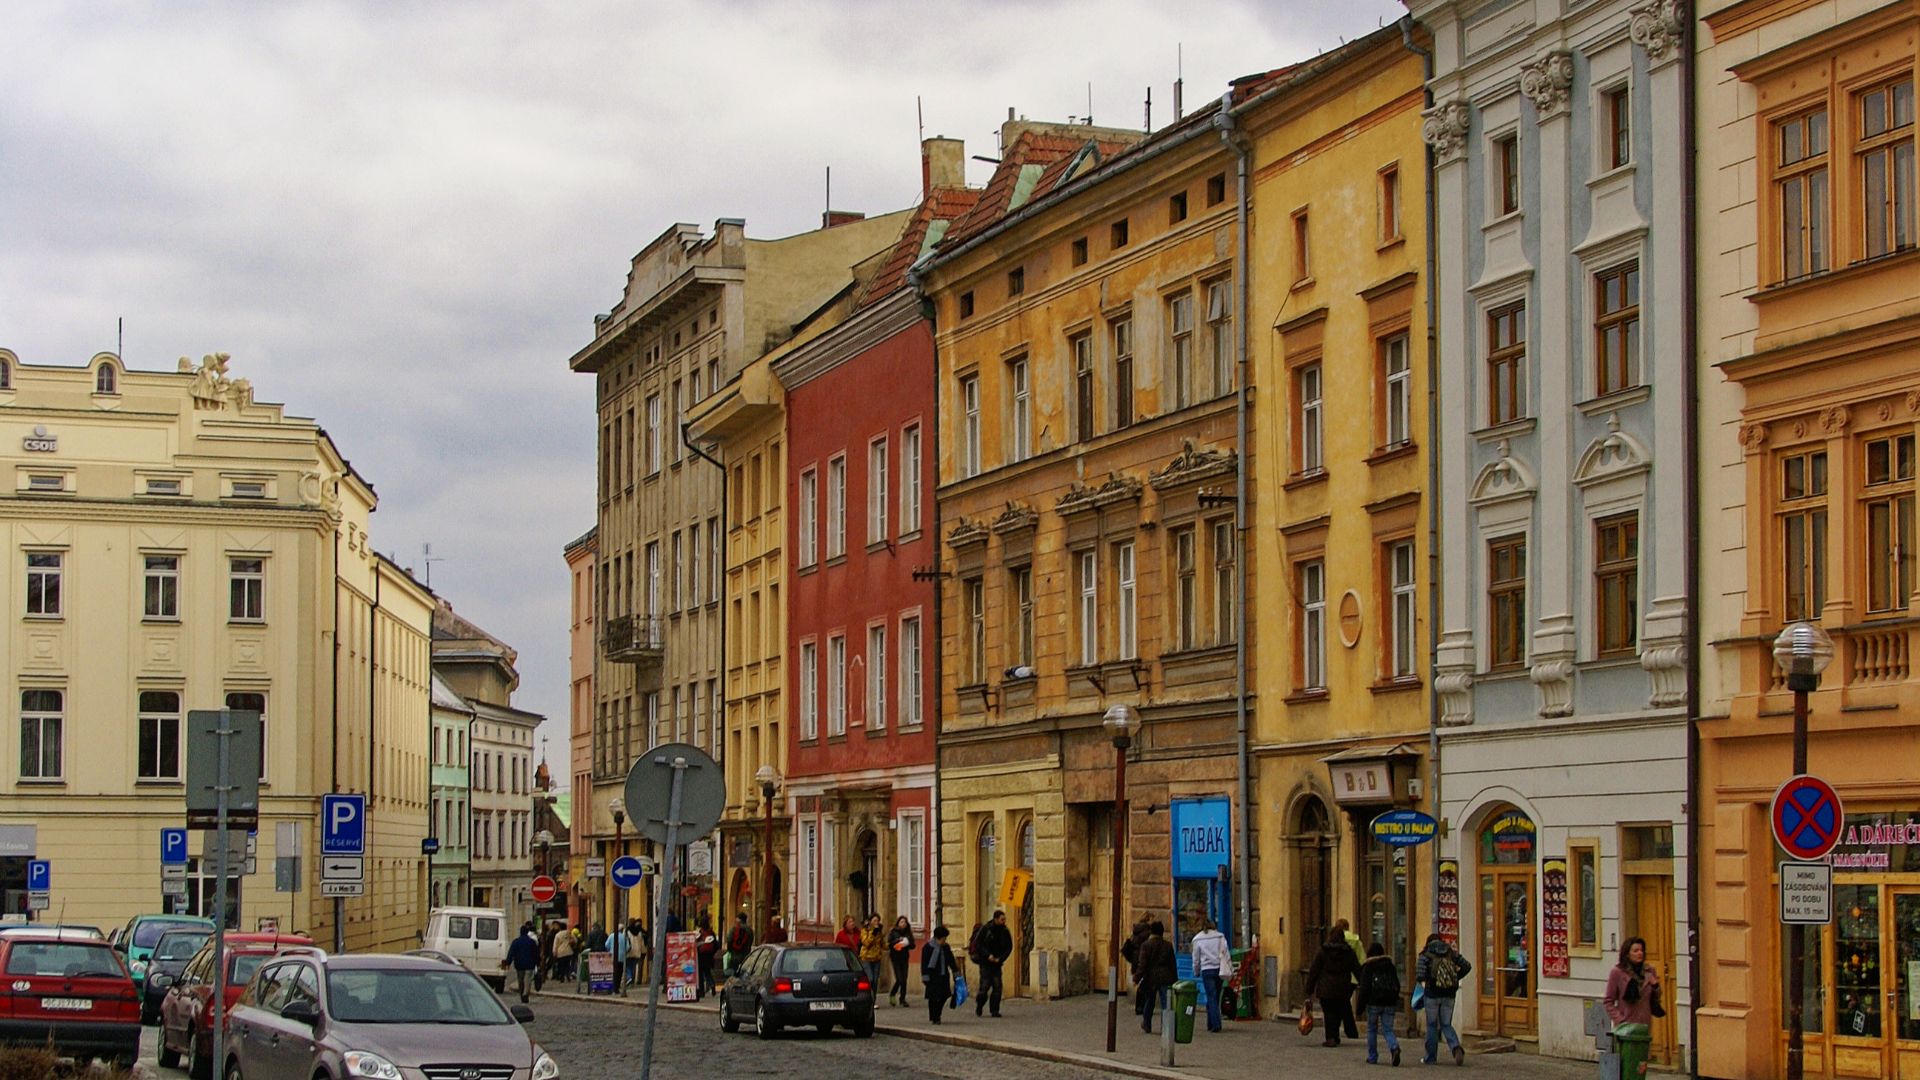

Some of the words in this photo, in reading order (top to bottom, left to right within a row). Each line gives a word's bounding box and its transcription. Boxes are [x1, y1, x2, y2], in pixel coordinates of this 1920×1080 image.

[1345, 772, 1355, 792] B
[1366, 770, 1376, 791] D
[332, 802, 356, 835] P
[1404, 822, 1411, 835] U
[1846, 825, 1859, 845] A
[1860, 818, 1920, 845] DÁREČ
[167, 833, 182, 852] P
[33, 864, 46, 881] P
[1797, 872, 1816, 880] MIMO
[1791, 895, 1801, 903] PO
[1803, 895, 1822, 903] DOBU
